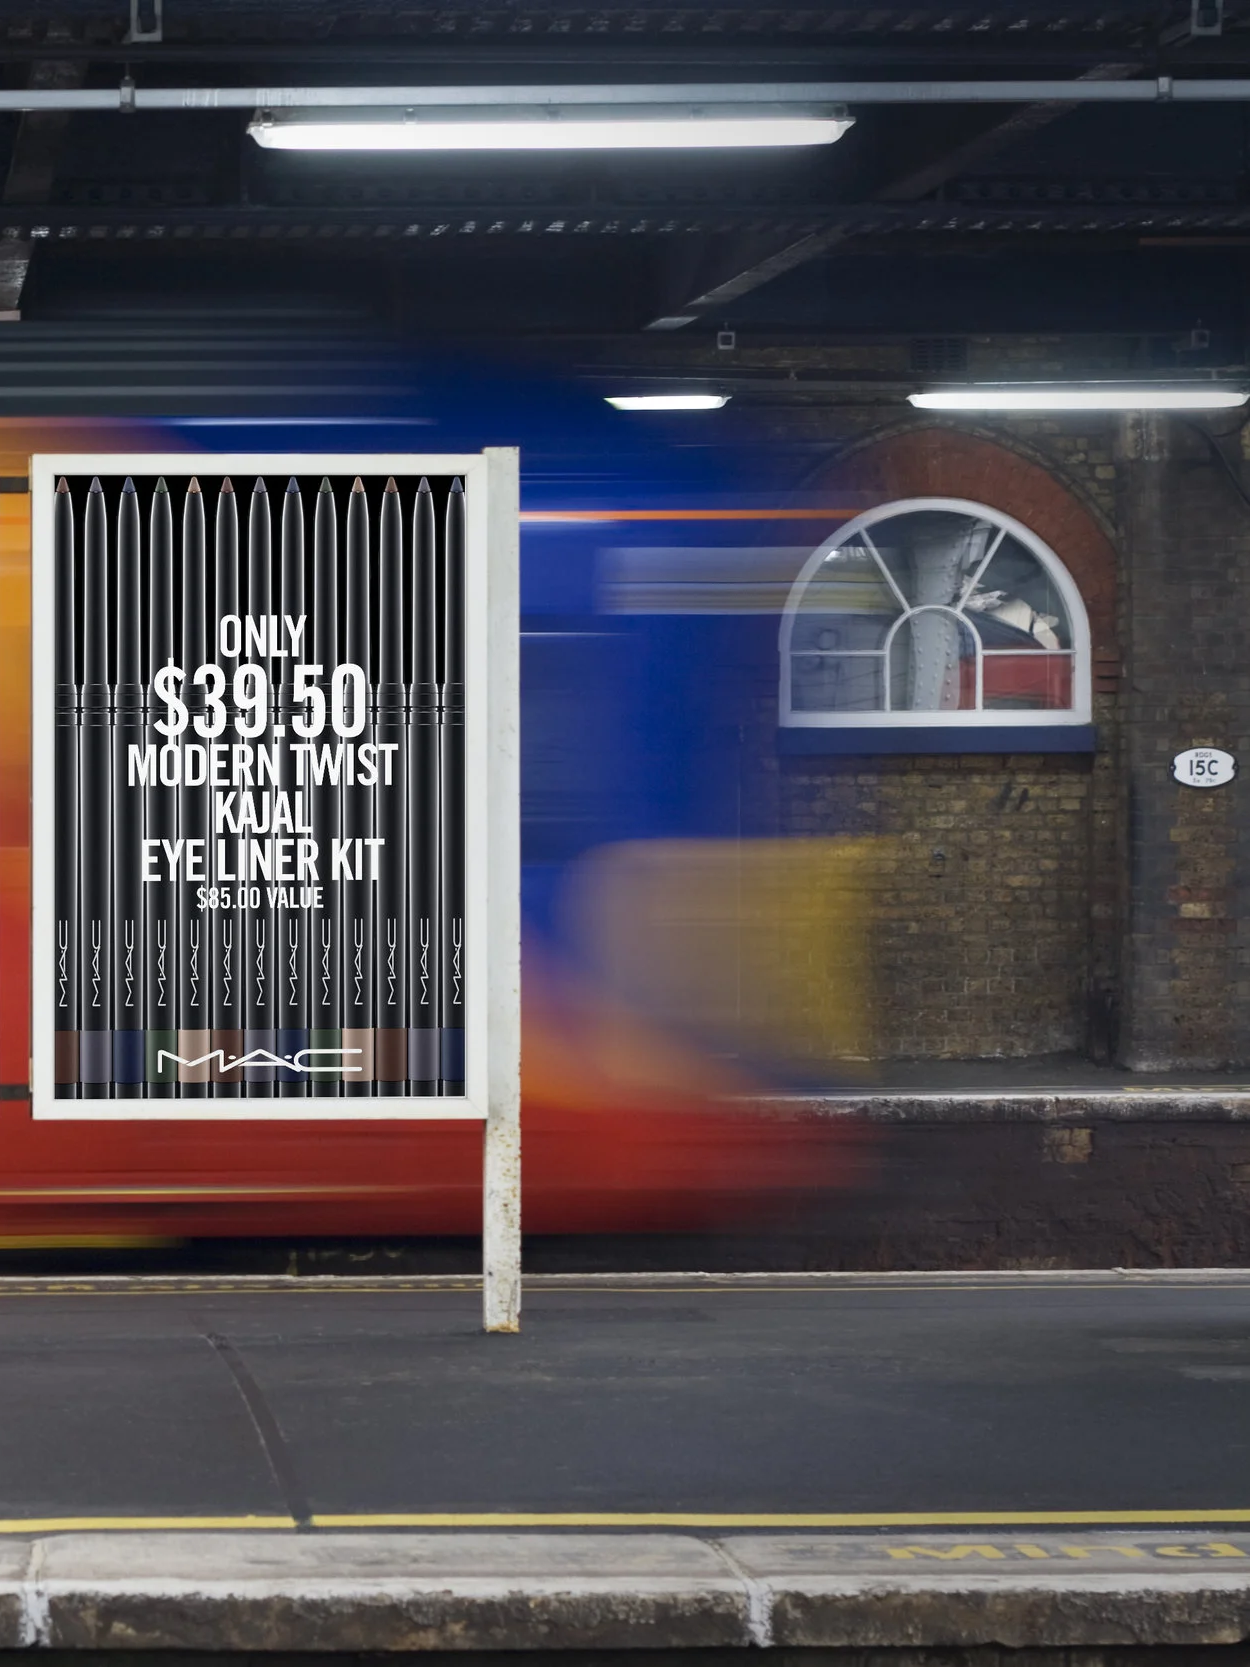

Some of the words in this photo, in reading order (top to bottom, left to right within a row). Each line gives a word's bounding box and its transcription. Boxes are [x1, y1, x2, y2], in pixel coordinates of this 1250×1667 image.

[220, 614, 307, 658] ONLY
[152, 657, 367, 745] $39.50
[127, 743, 280, 787] MODERN
[289, 743, 399, 787] TWIST
[1189, 760, 1218, 776] 15C
[215, 790, 314, 834] KAJAL
[141, 838, 207, 882] EYE
[217, 838, 320, 882] LINER
[331, 838, 386, 882] KIT
[196, 885, 261, 912] $85.00
[266, 887, 324, 909] VALUE
[884, 1542, 1249, 1560] Mind
